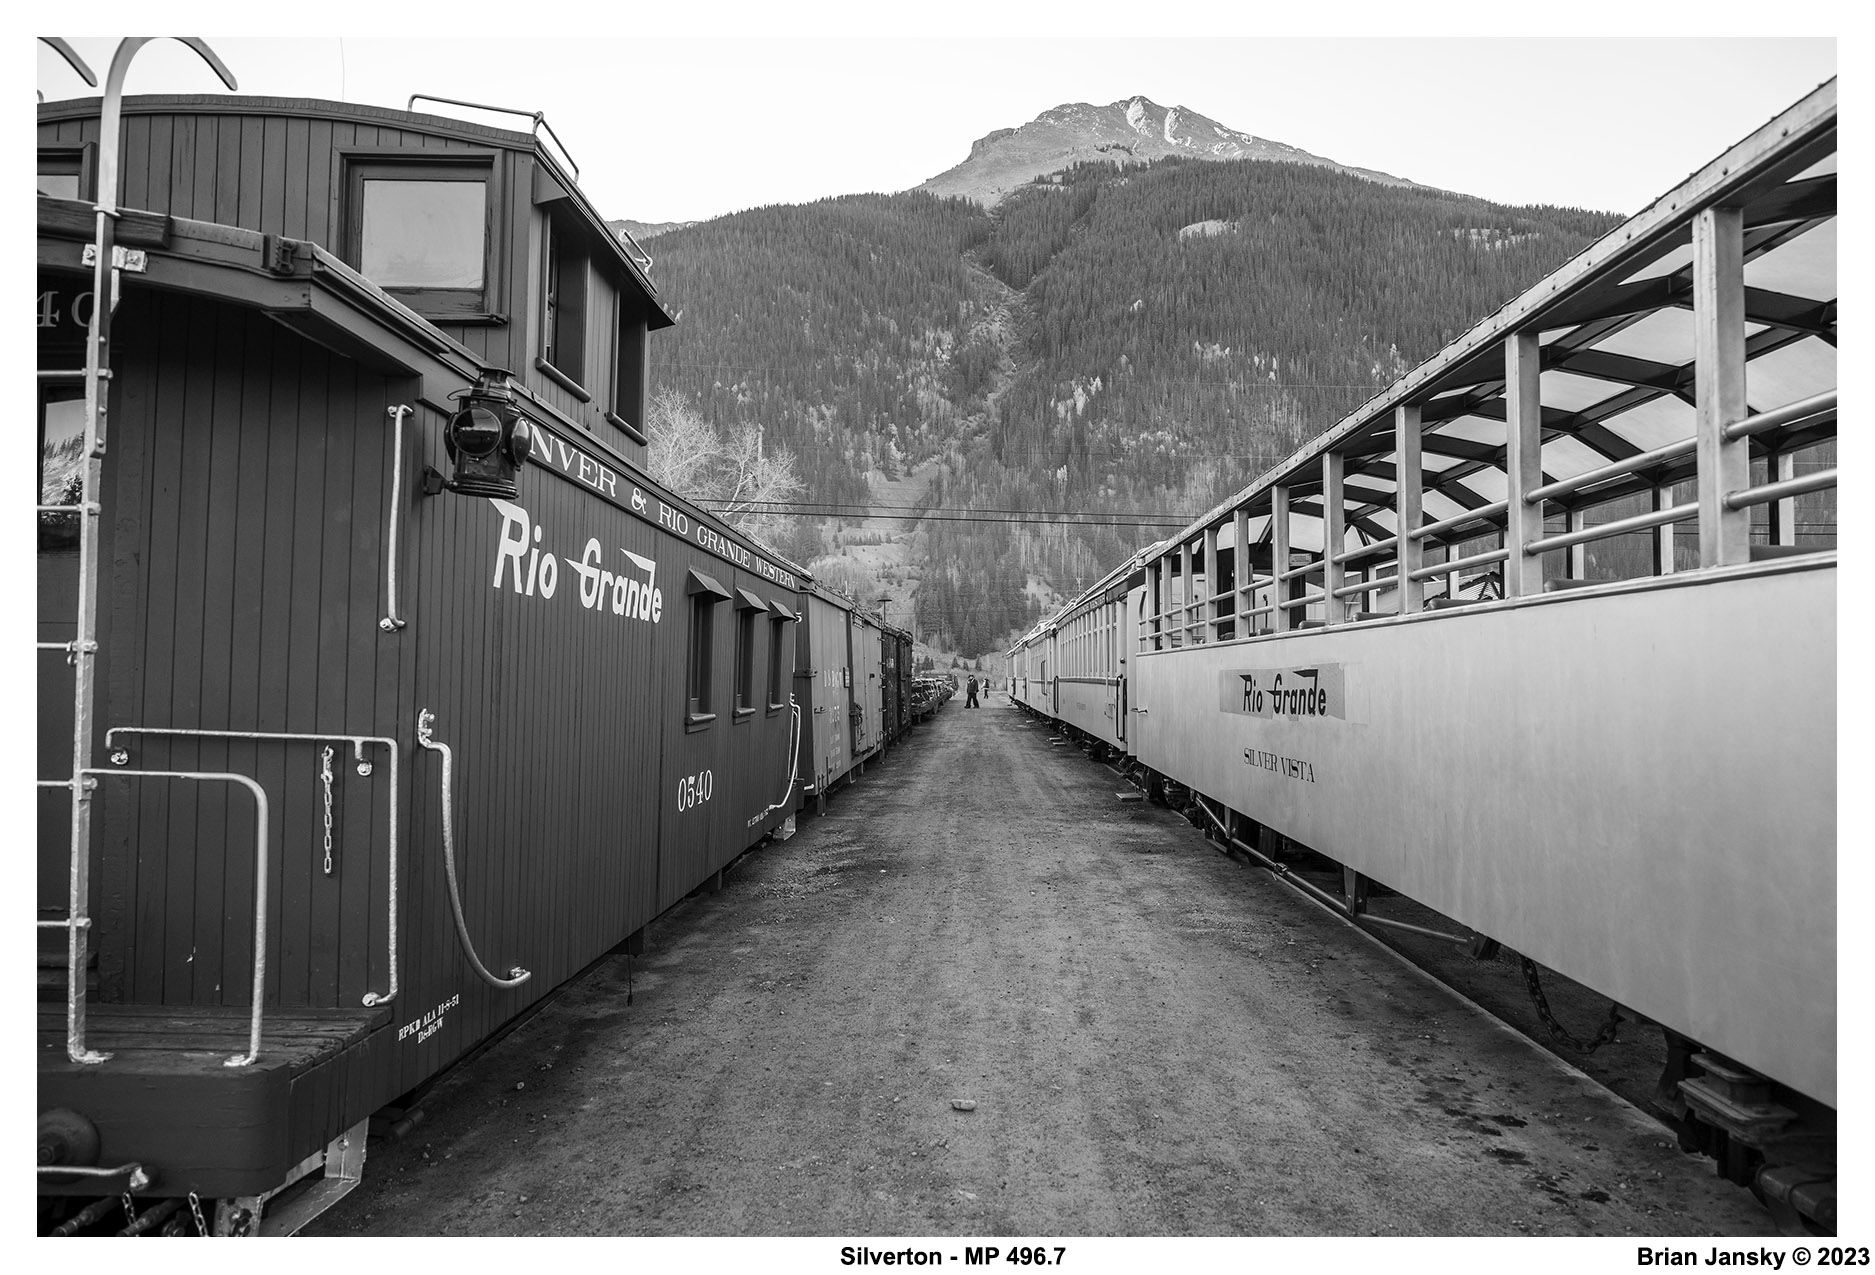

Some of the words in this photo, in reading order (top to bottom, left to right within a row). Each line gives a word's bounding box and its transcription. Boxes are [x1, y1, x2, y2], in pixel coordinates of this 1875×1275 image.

[527, 420, 617, 498] NVER
[631, 488, 647, 515] &
[658, 501, 689, 535] RIO
[697, 525, 751, 569] GRANDE
[755, 555, 797, 589] WESTERN
[489, 498, 558, 600] Rio
[564, 537, 663, 624] Grande
[1239, 674, 1263, 713] Rio
[1266, 668, 1327, 716] Grande
[1243, 747, 1278, 772] SILVER
[1280, 756, 1316, 783] VISTA
[678, 769, 712, 812] 0540
[422, 1009, 436, 1027] ALA
